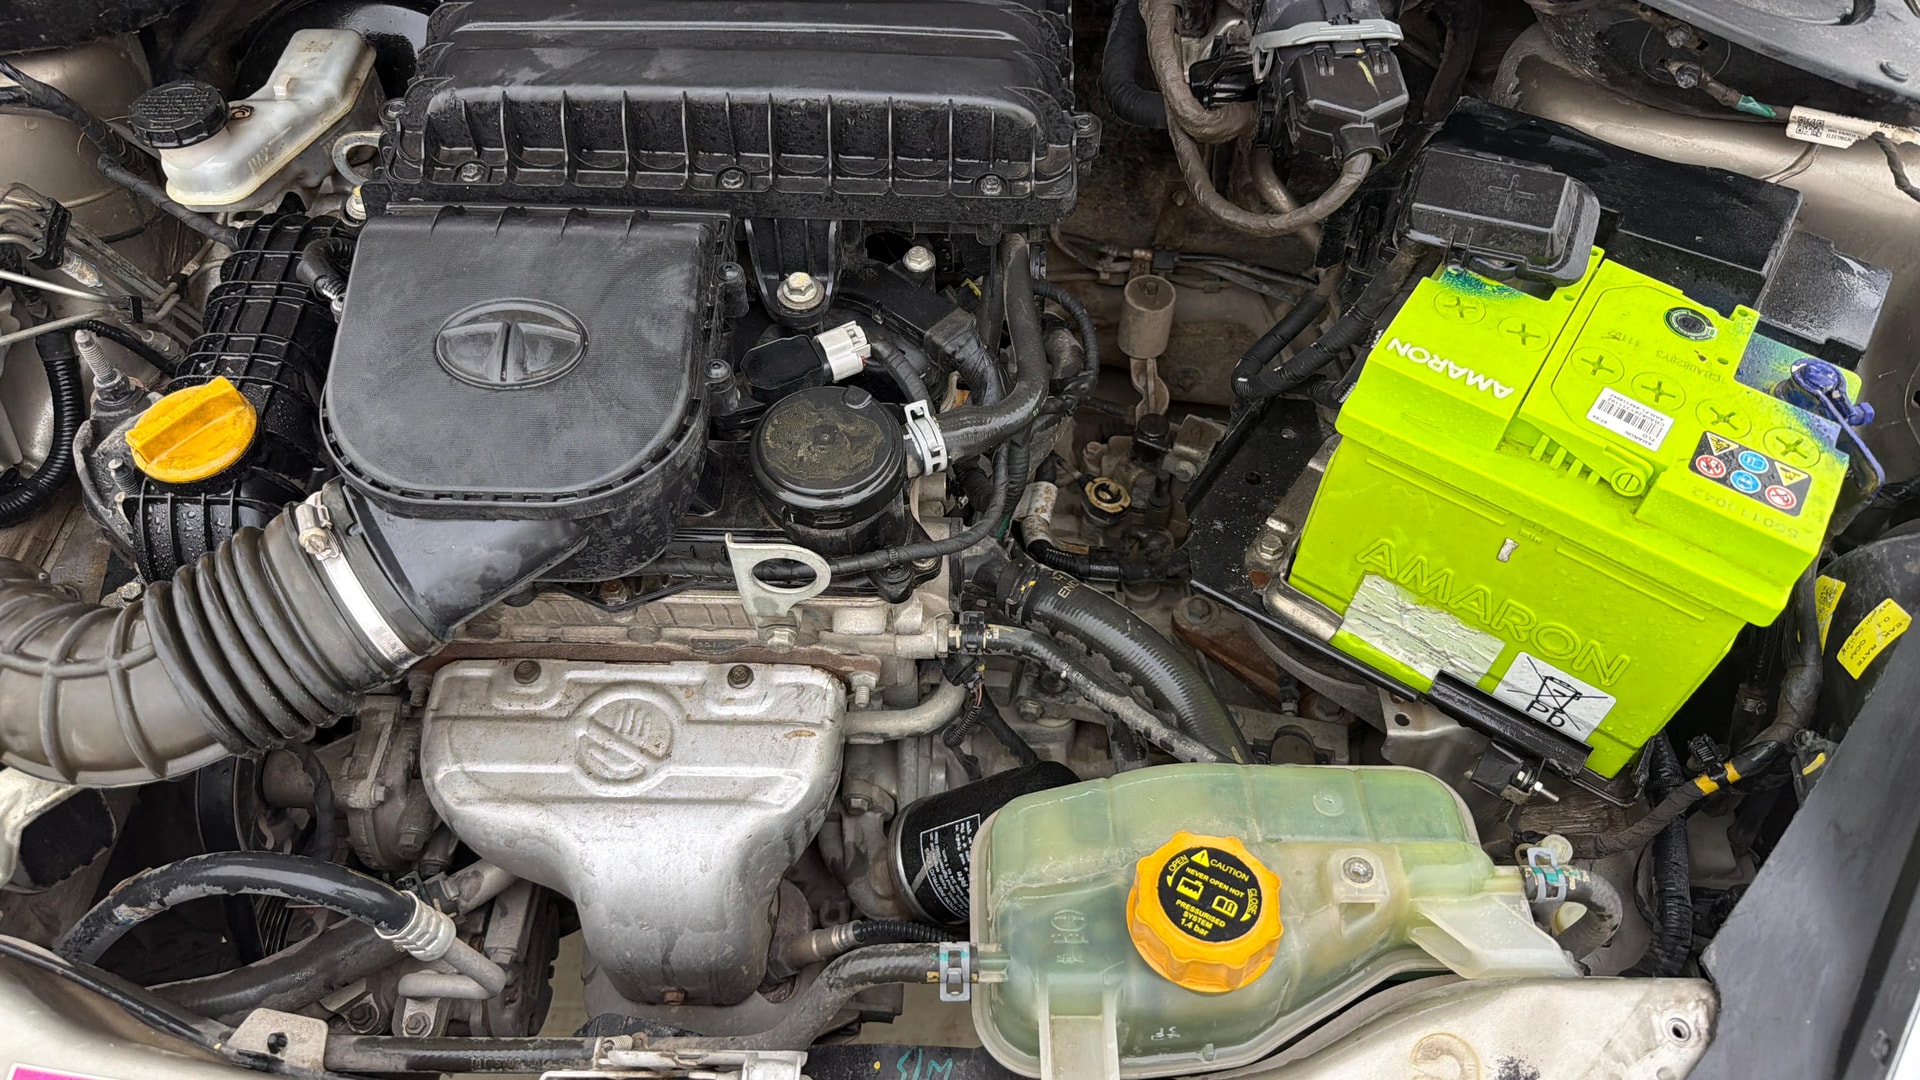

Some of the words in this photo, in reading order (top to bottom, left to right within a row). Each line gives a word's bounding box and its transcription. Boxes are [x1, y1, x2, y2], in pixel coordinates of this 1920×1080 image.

[1386, 337, 1514, 399] AMARON
[1625, 431, 1652, 446] AMARON
[1356, 538, 1631, 686] AMARON
[1525, 698, 1566, 728] Pb
[1168, 854, 1189, 872] OPEN
[1210, 859, 1250, 882] CAUTION
[1186, 867, 1209, 882] NEVER
[1209, 877, 1229, 892] OPEN
[1229, 886, 1245, 898] HOT
[1175, 899, 1226, 928] PRESSURISED
[1248, 888, 1259, 915] CLOSE
[1180, 918, 1193, 930] 1.4
[1193, 925, 1209, 936] bar
[1182, 911, 1213, 929] SYSTEM
